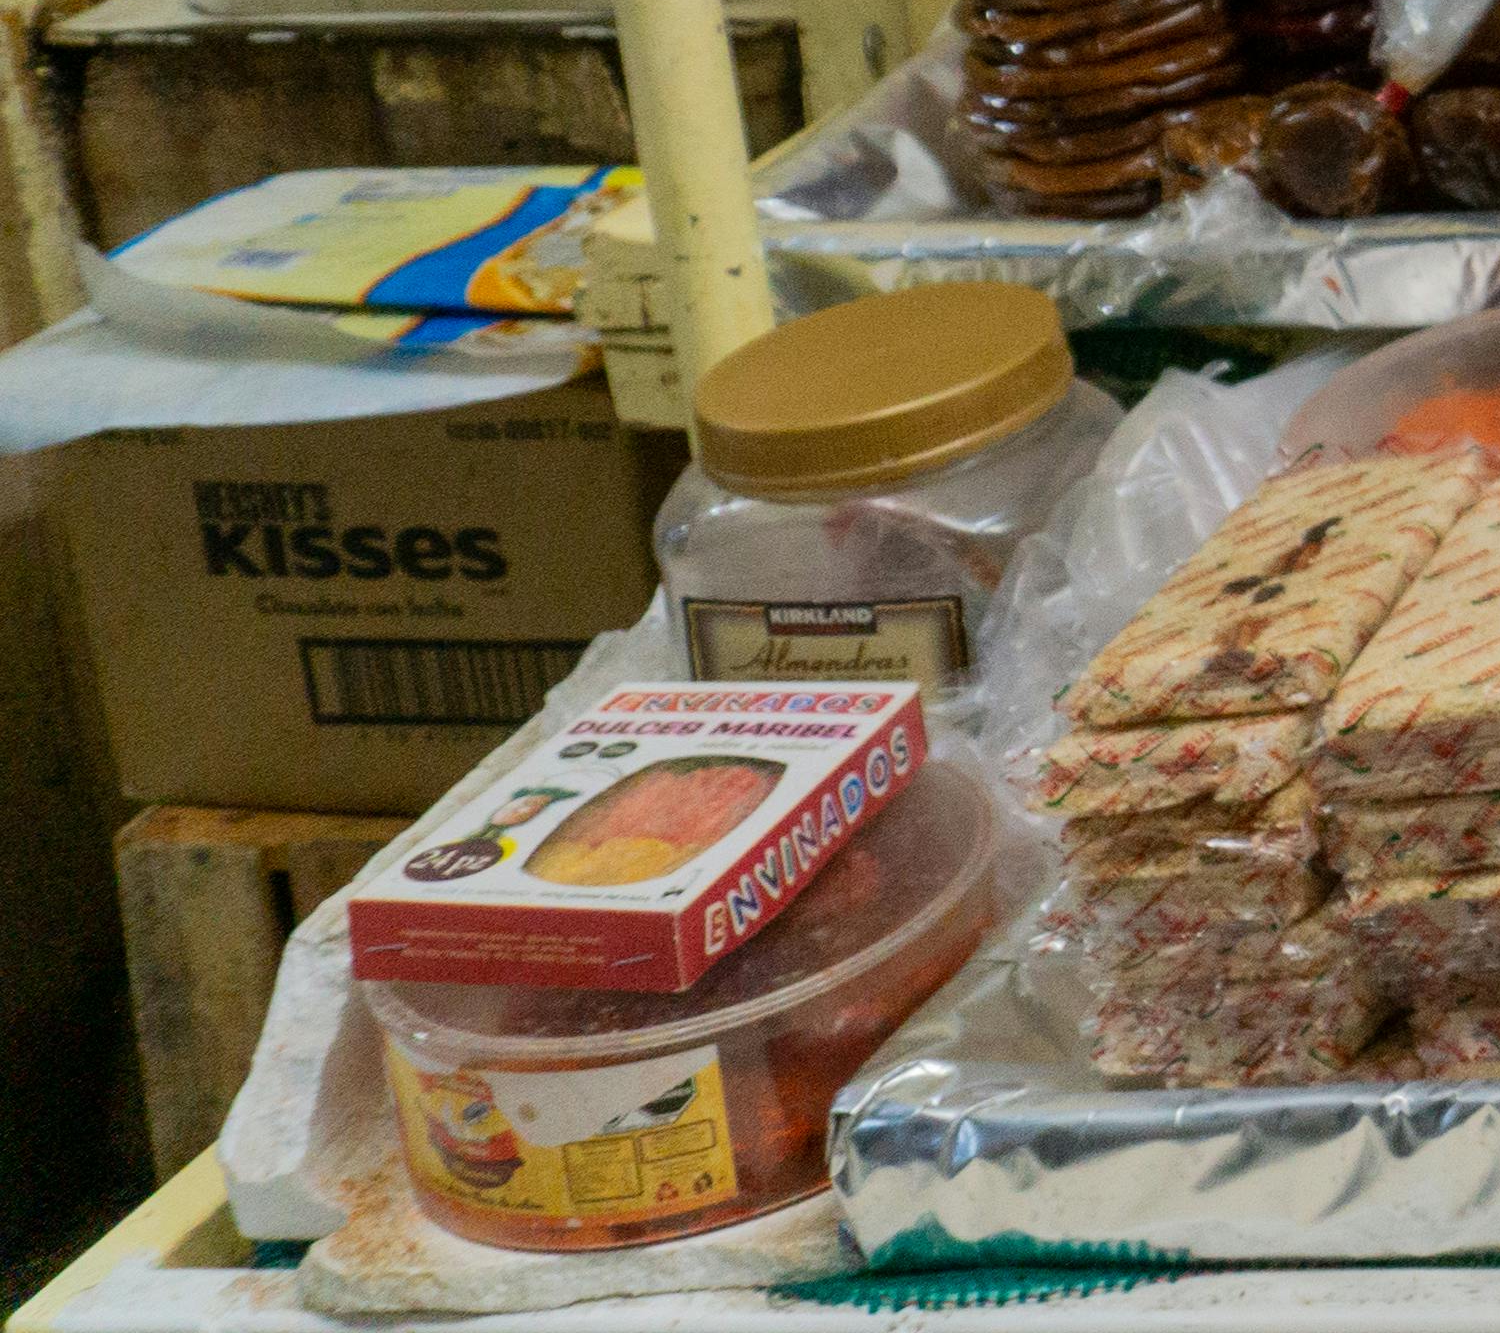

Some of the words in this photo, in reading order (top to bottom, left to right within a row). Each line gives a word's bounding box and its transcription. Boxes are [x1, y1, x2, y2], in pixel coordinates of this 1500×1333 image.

[769, 607, 874, 625] KIRKLAND
[728, 637, 910, 673] Almendras
[602, 692, 880, 715] ENVINADOS
[708, 719, 862, 741] MARIBEL
[704, 725, 912, 957] ENVINADOS
